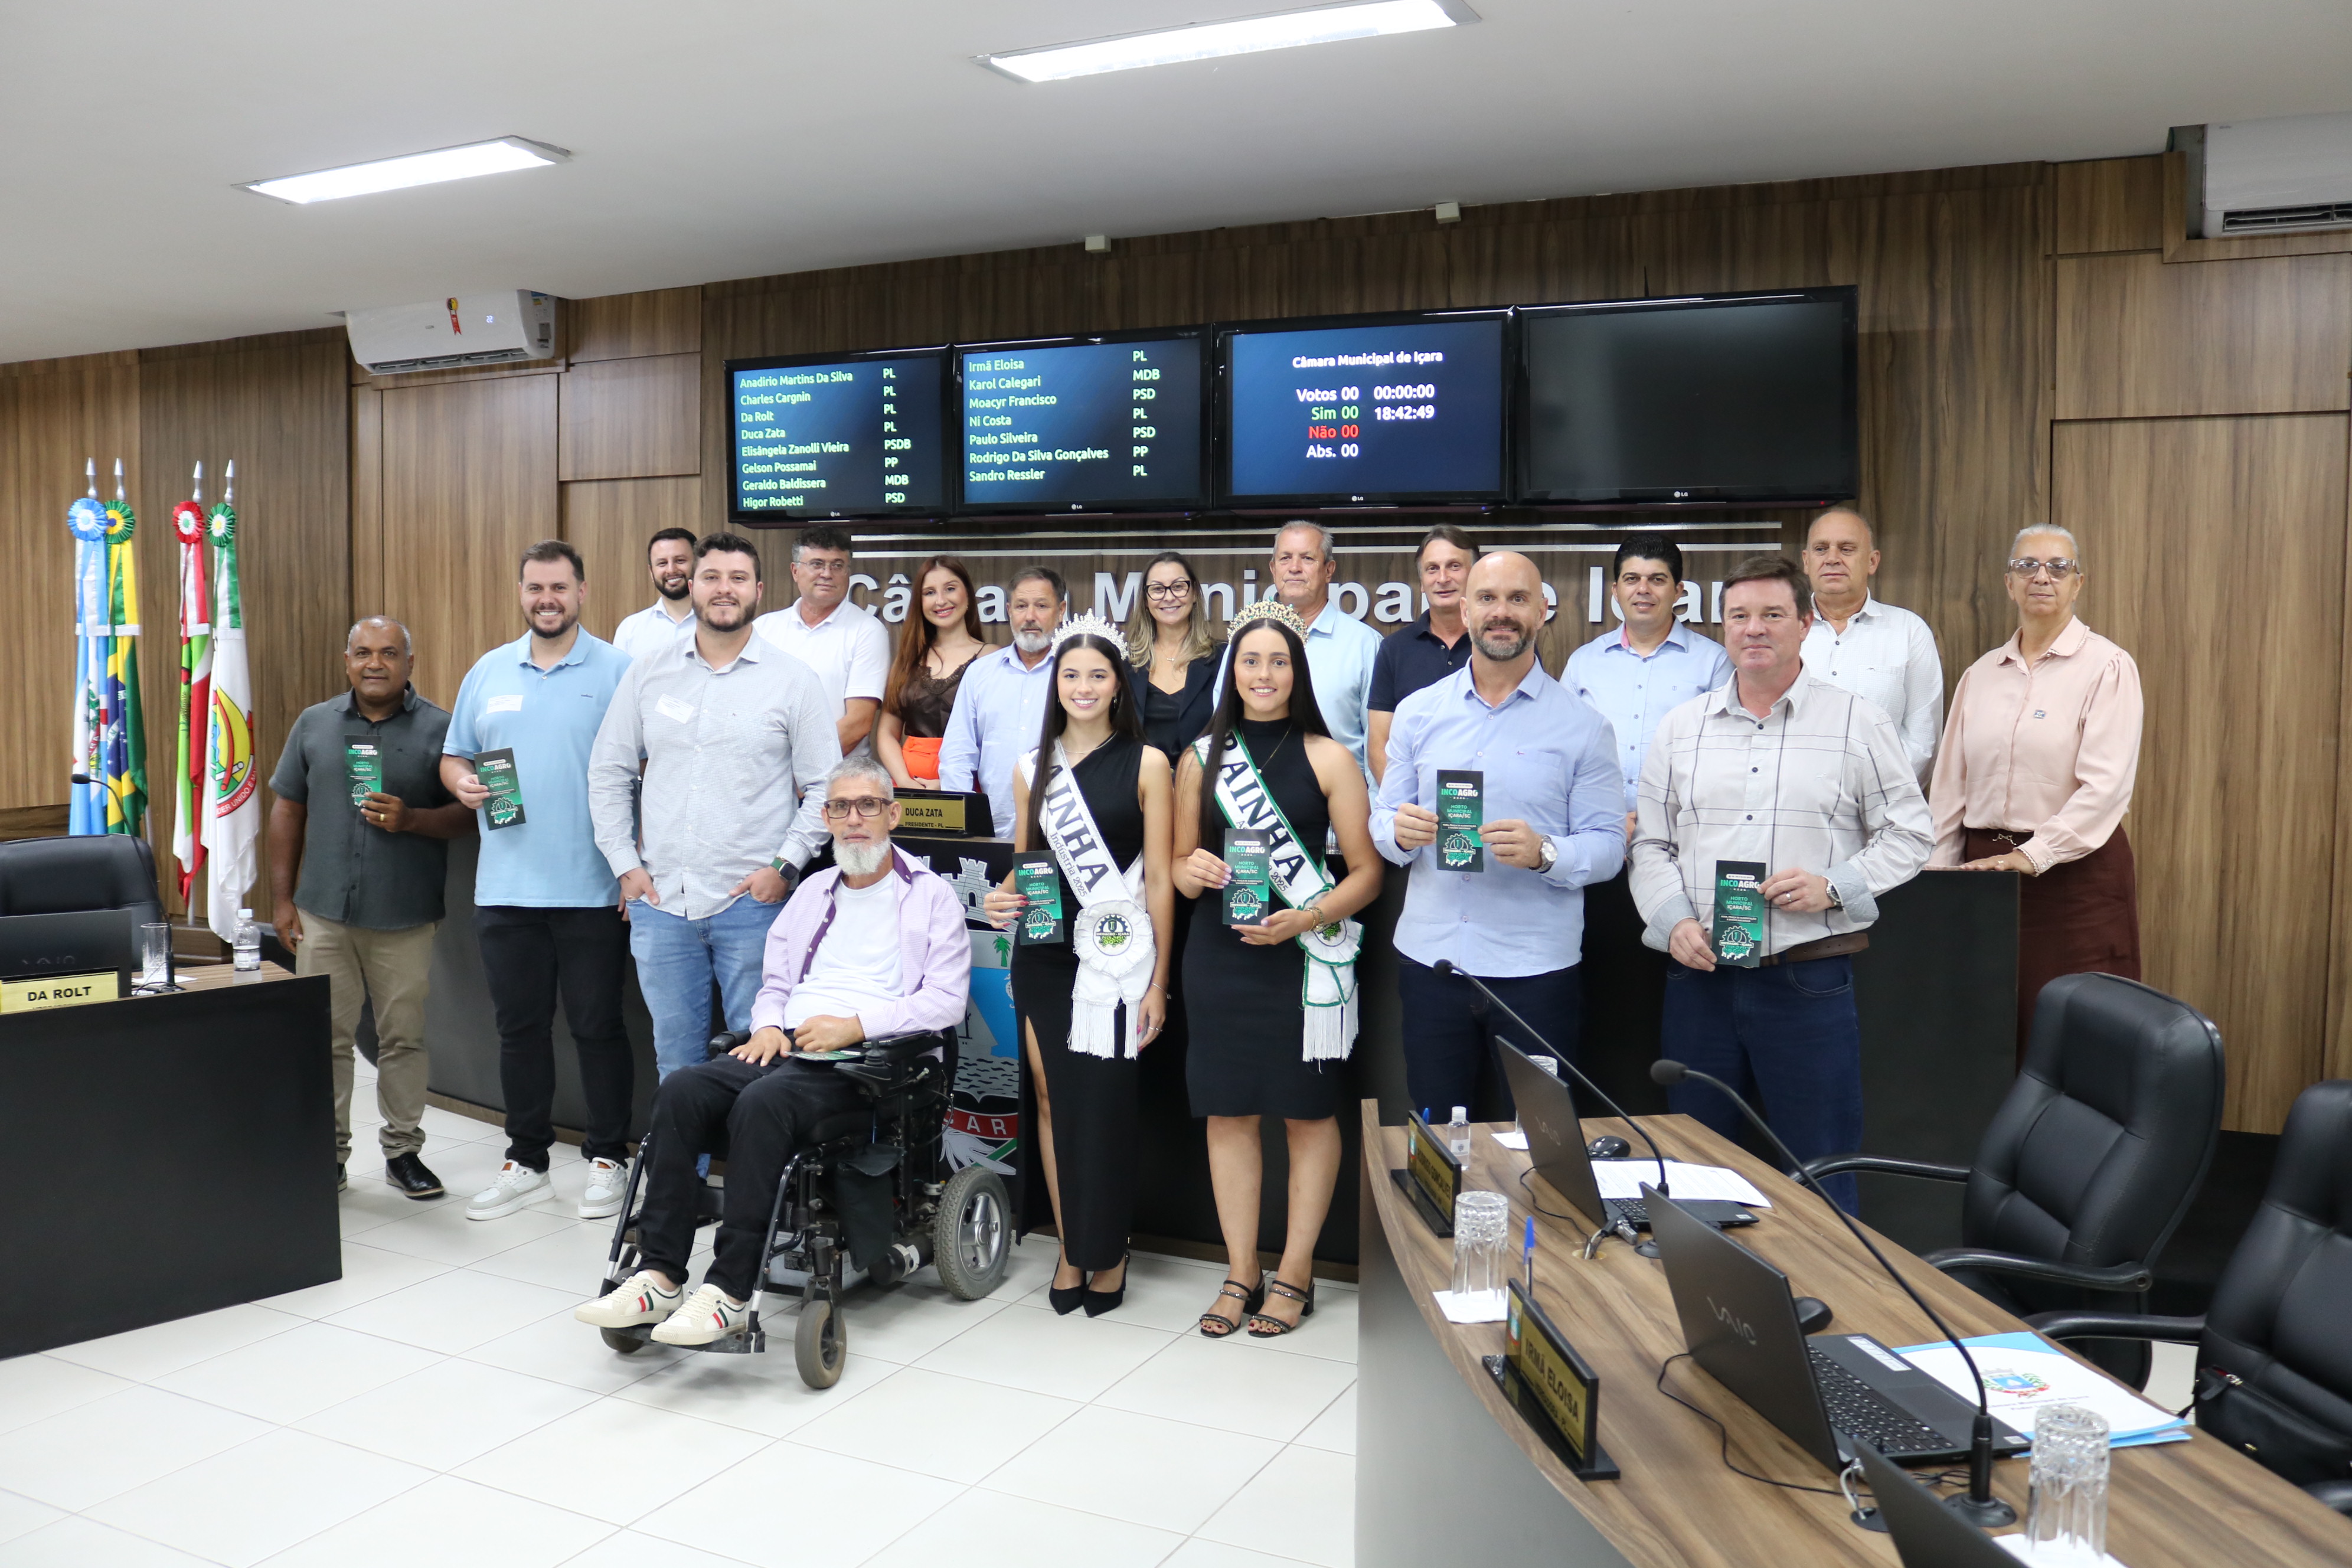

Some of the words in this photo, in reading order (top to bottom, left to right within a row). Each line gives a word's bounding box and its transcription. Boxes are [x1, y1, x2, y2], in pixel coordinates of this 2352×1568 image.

[1133, 351, 1147, 361] PL
[1292, 355, 1335, 368] Câmara
[1338, 351, 1394, 367] Municipal
[1396, 352, 1412, 364] de
[1414, 351, 1443, 365] Içara
[969, 361, 991, 372] Irmã
[994, 359, 1024, 370] Eloisa
[740, 376, 778, 388] Anadirio
[779, 374, 814, 386] Martins
[816, 373, 828, 383] Da
[830, 371, 852, 381] Silva
[883, 368, 896, 378] PL
[1133, 369, 1160, 381] MDB
[969, 378, 996, 390] Karol
[998, 375, 1041, 390] Calegari
[883, 386, 896, 396] PL
[1133, 388, 1156, 400] PSD
[1296, 388, 1337, 401] Votos
[1341, 387, 1359, 400] 00
[1374, 384, 1435, 399] 00:00:00
[740, 393, 773, 405] Charles
[776, 391, 811, 404] Cargnin
[969, 397, 1006, 410] Moacyr
[1009, 395, 1057, 406] Francisco
[884, 404, 897, 414] PL
[1133, 408, 1148, 419] PL
[1312, 407, 1337, 420] Sim
[1341, 406, 1359, 419] 00
[1374, 404, 1435, 420] 18:42:49
[741, 413, 753, 422] Da
[755, 411, 774, 421] Rolt
[969, 416, 981, 426] Ni
[983, 415, 1012, 426] Costa
[741, 429, 763, 439] Duca
[765, 427, 786, 438] Zata
[884, 422, 897, 432] PL
[1133, 426, 1156, 438] PSD
[1309, 426, 1337, 439] Não
[1341, 424, 1358, 438] 00
[884, 439, 912, 450] PSDB
[969, 433, 998, 445] Paulo
[999, 431, 1038, 444] Silveira
[741, 445, 786, 458] Elisângela
[789, 442, 820, 454] Zanolli
[822, 442, 849, 452] Vieira
[969, 450, 1010, 465] Rodrigo
[1012, 450, 1025, 462] Da
[1028, 449, 1053, 460] Silva
[1055, 447, 1109, 463] Gonçalves
[1133, 446, 1148, 457] PP
[1306, 445, 1336, 458] Abs.
[1341, 444, 1358, 457] 00
[742, 463, 772, 473] Gelson
[775, 460, 816, 472] Possamai
[885, 457, 898, 468] PP
[969, 469, 1005, 482] Sandro
[1007, 468, 1045, 480] Ressler
[1133, 465, 1148, 476] PL
[743, 478, 778, 491] Geraldo
[779, 476, 826, 489] Baldissera
[885, 475, 909, 485] MDB
[743, 496, 767, 509] Higor
[769, 495, 803, 507] Robetti
[886, 492, 905, 503] PSD
[480, 762, 511, 772] INCOAGRO
[906, 808, 924, 816] DUCA
[926, 808, 943, 817] ZATA
[1051, 832, 1076, 876] Indústria
[1073, 877, 1087, 897] 2025
[1018, 867, 1053, 876] INCOAGRO
[1270, 871, 1288, 891] 2025
[1720, 880, 1759, 888] INCOAGRO
[28, 991, 48, 1001] DA
[53, 986, 92, 999] ROLT
[1548, 1367, 1579, 1423] ELOISA
